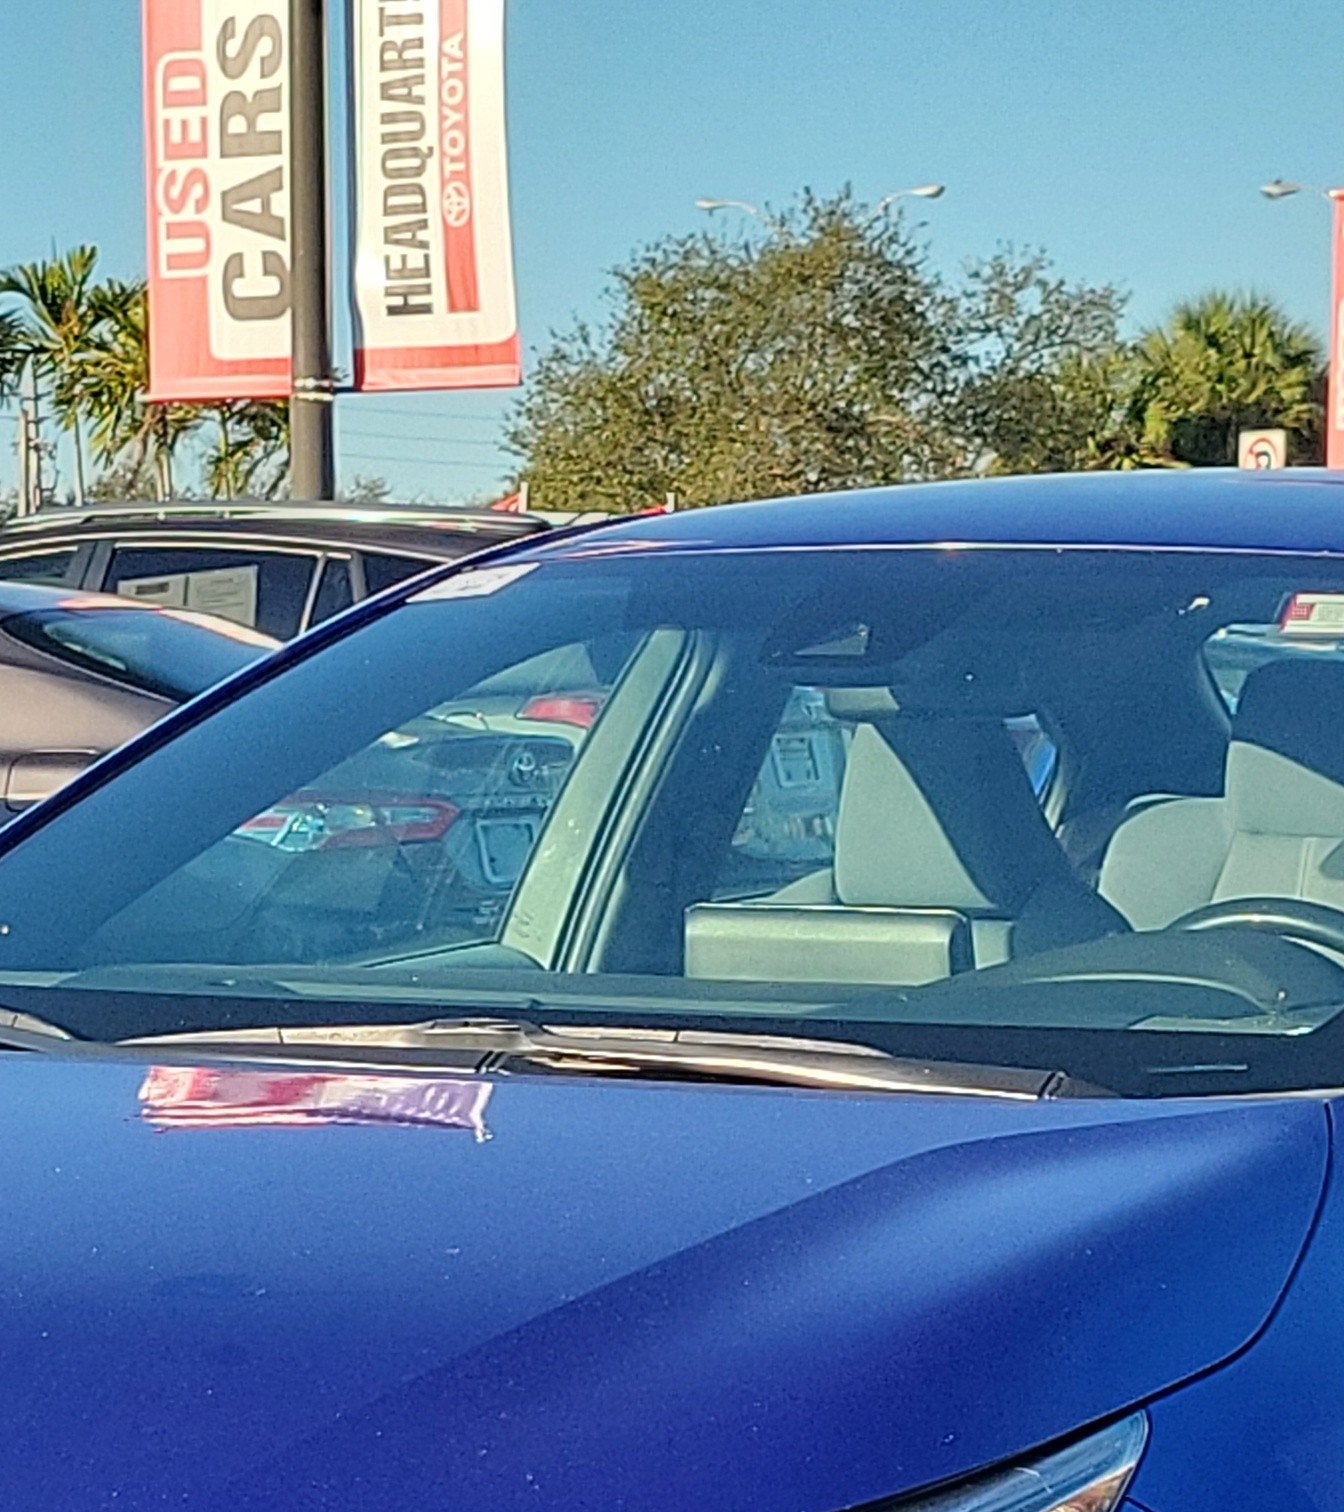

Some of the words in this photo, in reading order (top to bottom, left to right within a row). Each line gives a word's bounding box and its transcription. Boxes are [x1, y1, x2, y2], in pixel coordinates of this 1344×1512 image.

[161, 57, 211, 271] USED
[215, 13, 291, 322] CARS
[378, 0, 434, 317] HEADQUART
[440, 31, 467, 172] TOYOTA
